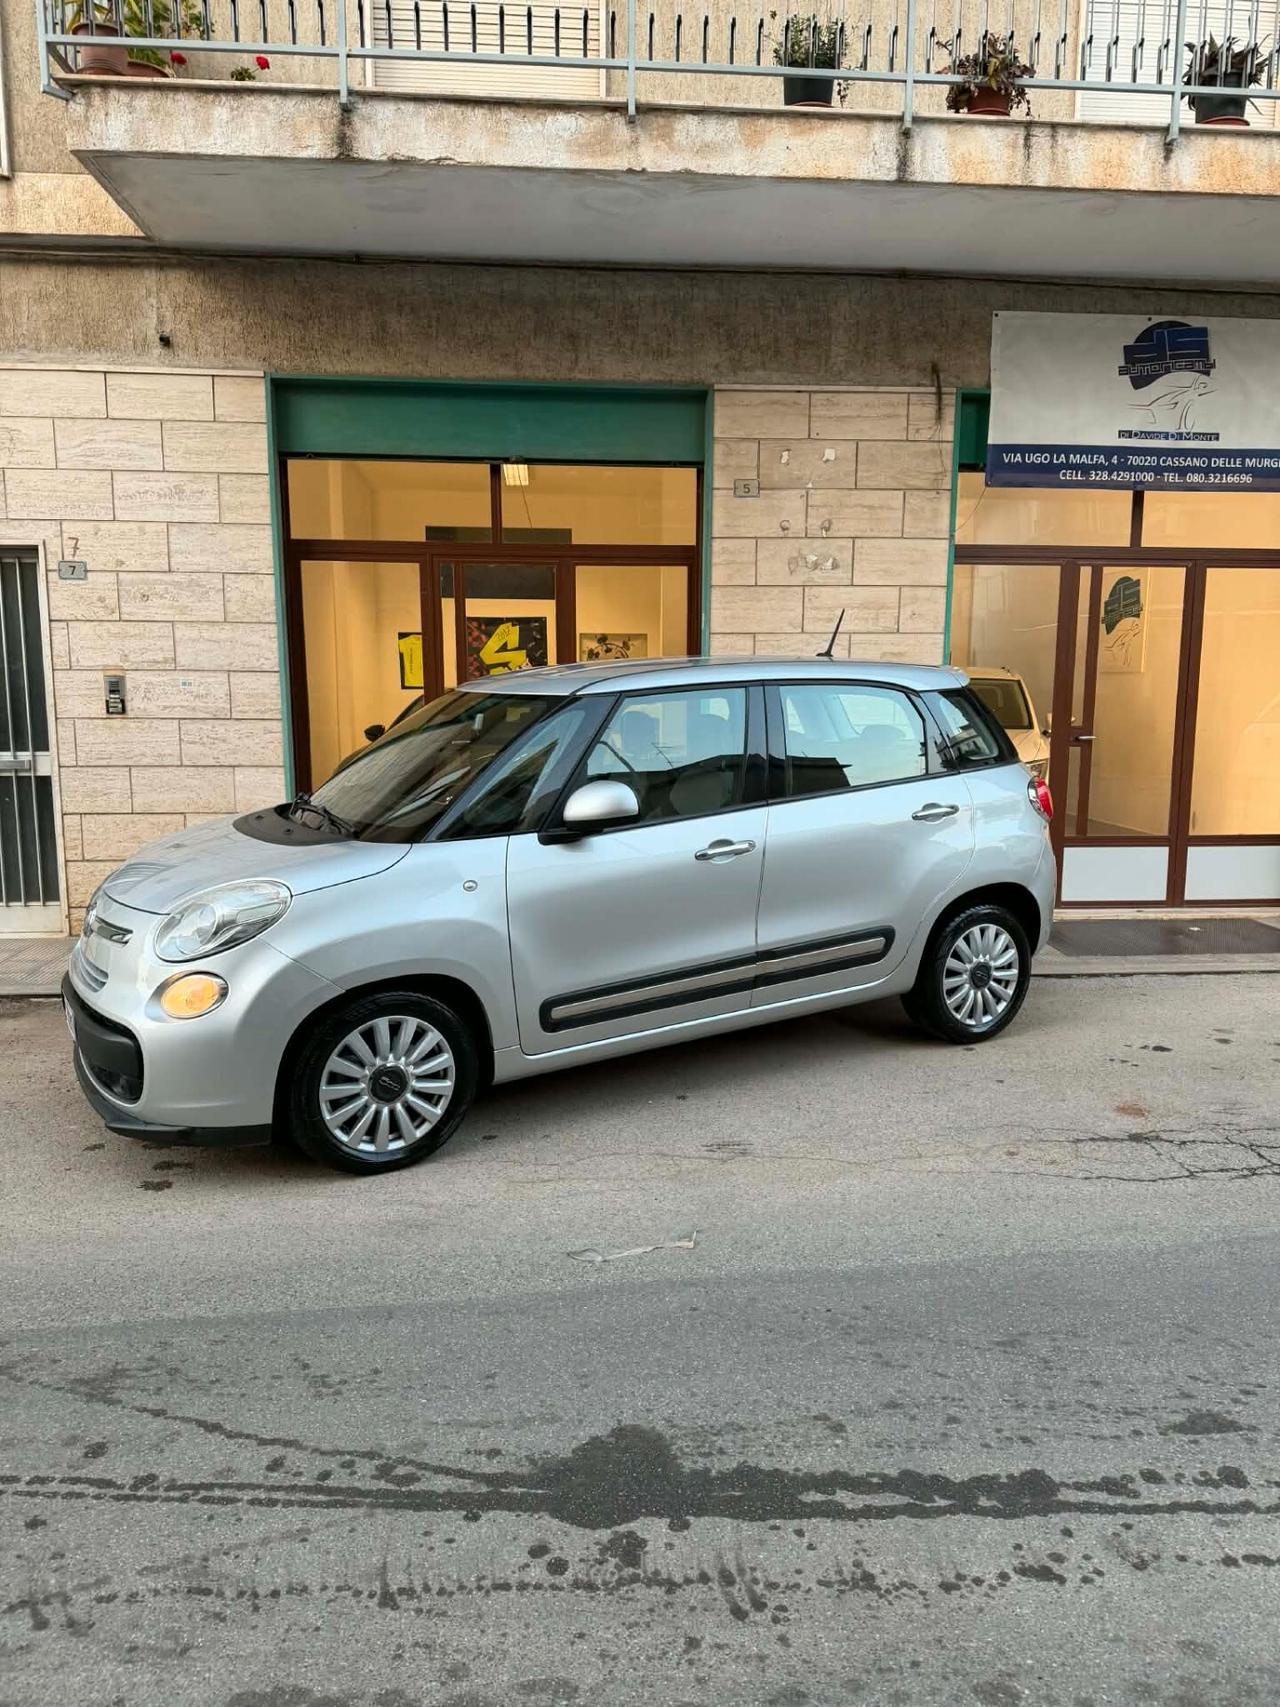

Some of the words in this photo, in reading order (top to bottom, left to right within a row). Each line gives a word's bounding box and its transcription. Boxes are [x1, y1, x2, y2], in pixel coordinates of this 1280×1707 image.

[1002, 453, 1022, 464] VIA
[1025, 453, 1050, 464] UGO
[1053, 453, 1066, 464] LA
[1069, 454, 1109, 466] MALFA,
[1111, 455, 1118, 465] 4
[1127, 455, 1157, 466] 70020
[1160, 456, 1208, 468] CASSANO
[1211, 457, 1242, 468] DELLE
[1245, 457, 1280, 468] MURG
[1059, 470, 1086, 480] CELL.
[1088, 470, 1154, 482] 328.4291000
[1163, 472, 1184, 483] TEL.
[1186, 473, 1253, 484] 080.3216696
[743, 483, 751, 494] 5
[68, 537, 80, 558] 7
[68, 565, 76, 575] 7
